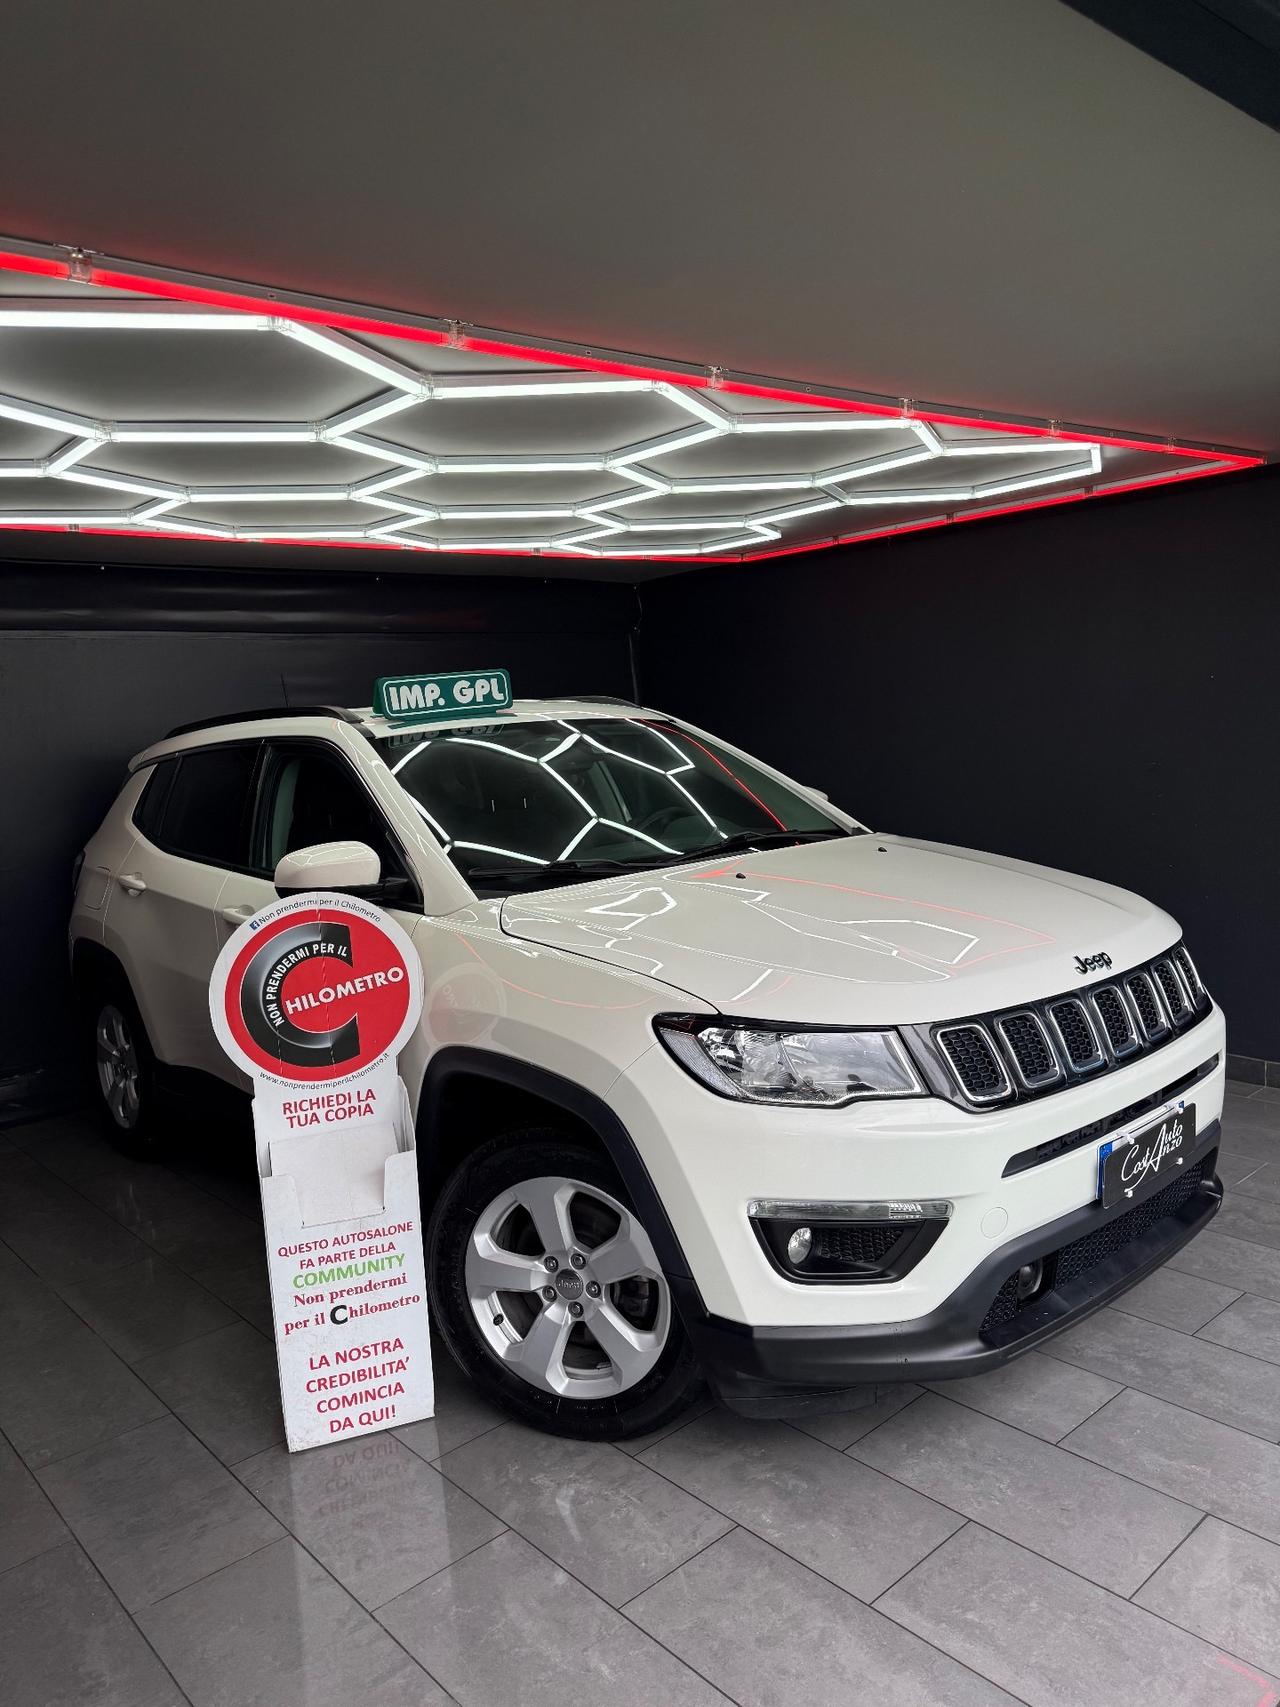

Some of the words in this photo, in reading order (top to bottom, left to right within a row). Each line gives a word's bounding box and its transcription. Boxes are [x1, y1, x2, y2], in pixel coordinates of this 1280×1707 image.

[389, 684, 446, 711] IMP.
[453, 678, 505, 704] GPL
[259, 912, 276, 925] Non
[276, 900, 318, 917] prendermi
[319, 899, 333, 908] per
[340, 900, 381, 922] Chilometro
[312, 943, 335, 955] PER
[338, 945, 348, 957] IL
[1074, 952, 1112, 974] Jeep
[266, 947, 310, 1000] PRENDERMI
[266, 1001, 285, 1027] NON
[282, 1092, 352, 1116] RICHIEDI
[356, 1088, 376, 1102] LA
[286, 1111, 320, 1129] TUA
[324, 1103, 374, 1122] COPIA
[278, 1238, 329, 1258] QUESTO
[332, 1221, 414, 1247] AUTOSALONE
[299, 1258, 315, 1270] FA
[318, 1249, 356, 1266] PARTE
[359, 1241, 396, 1258] DELLA
[292, 1253, 405, 1289] COMMUNITY
[294, 1293, 325, 1308] Non
[329, 1272, 408, 1304] prendermi
[284, 1318, 310, 1336] per
[314, 1312, 326, 1327] il
[329, 1294, 421, 1326] Chilometro
[309, 1355, 330, 1370] LA
[335, 1338, 404, 1365] NOSTRA
[316, 1382, 405, 1413] COMINCIA
[329, 1416, 355, 1433] DA
[358, 1404, 396, 1426] QUI!
